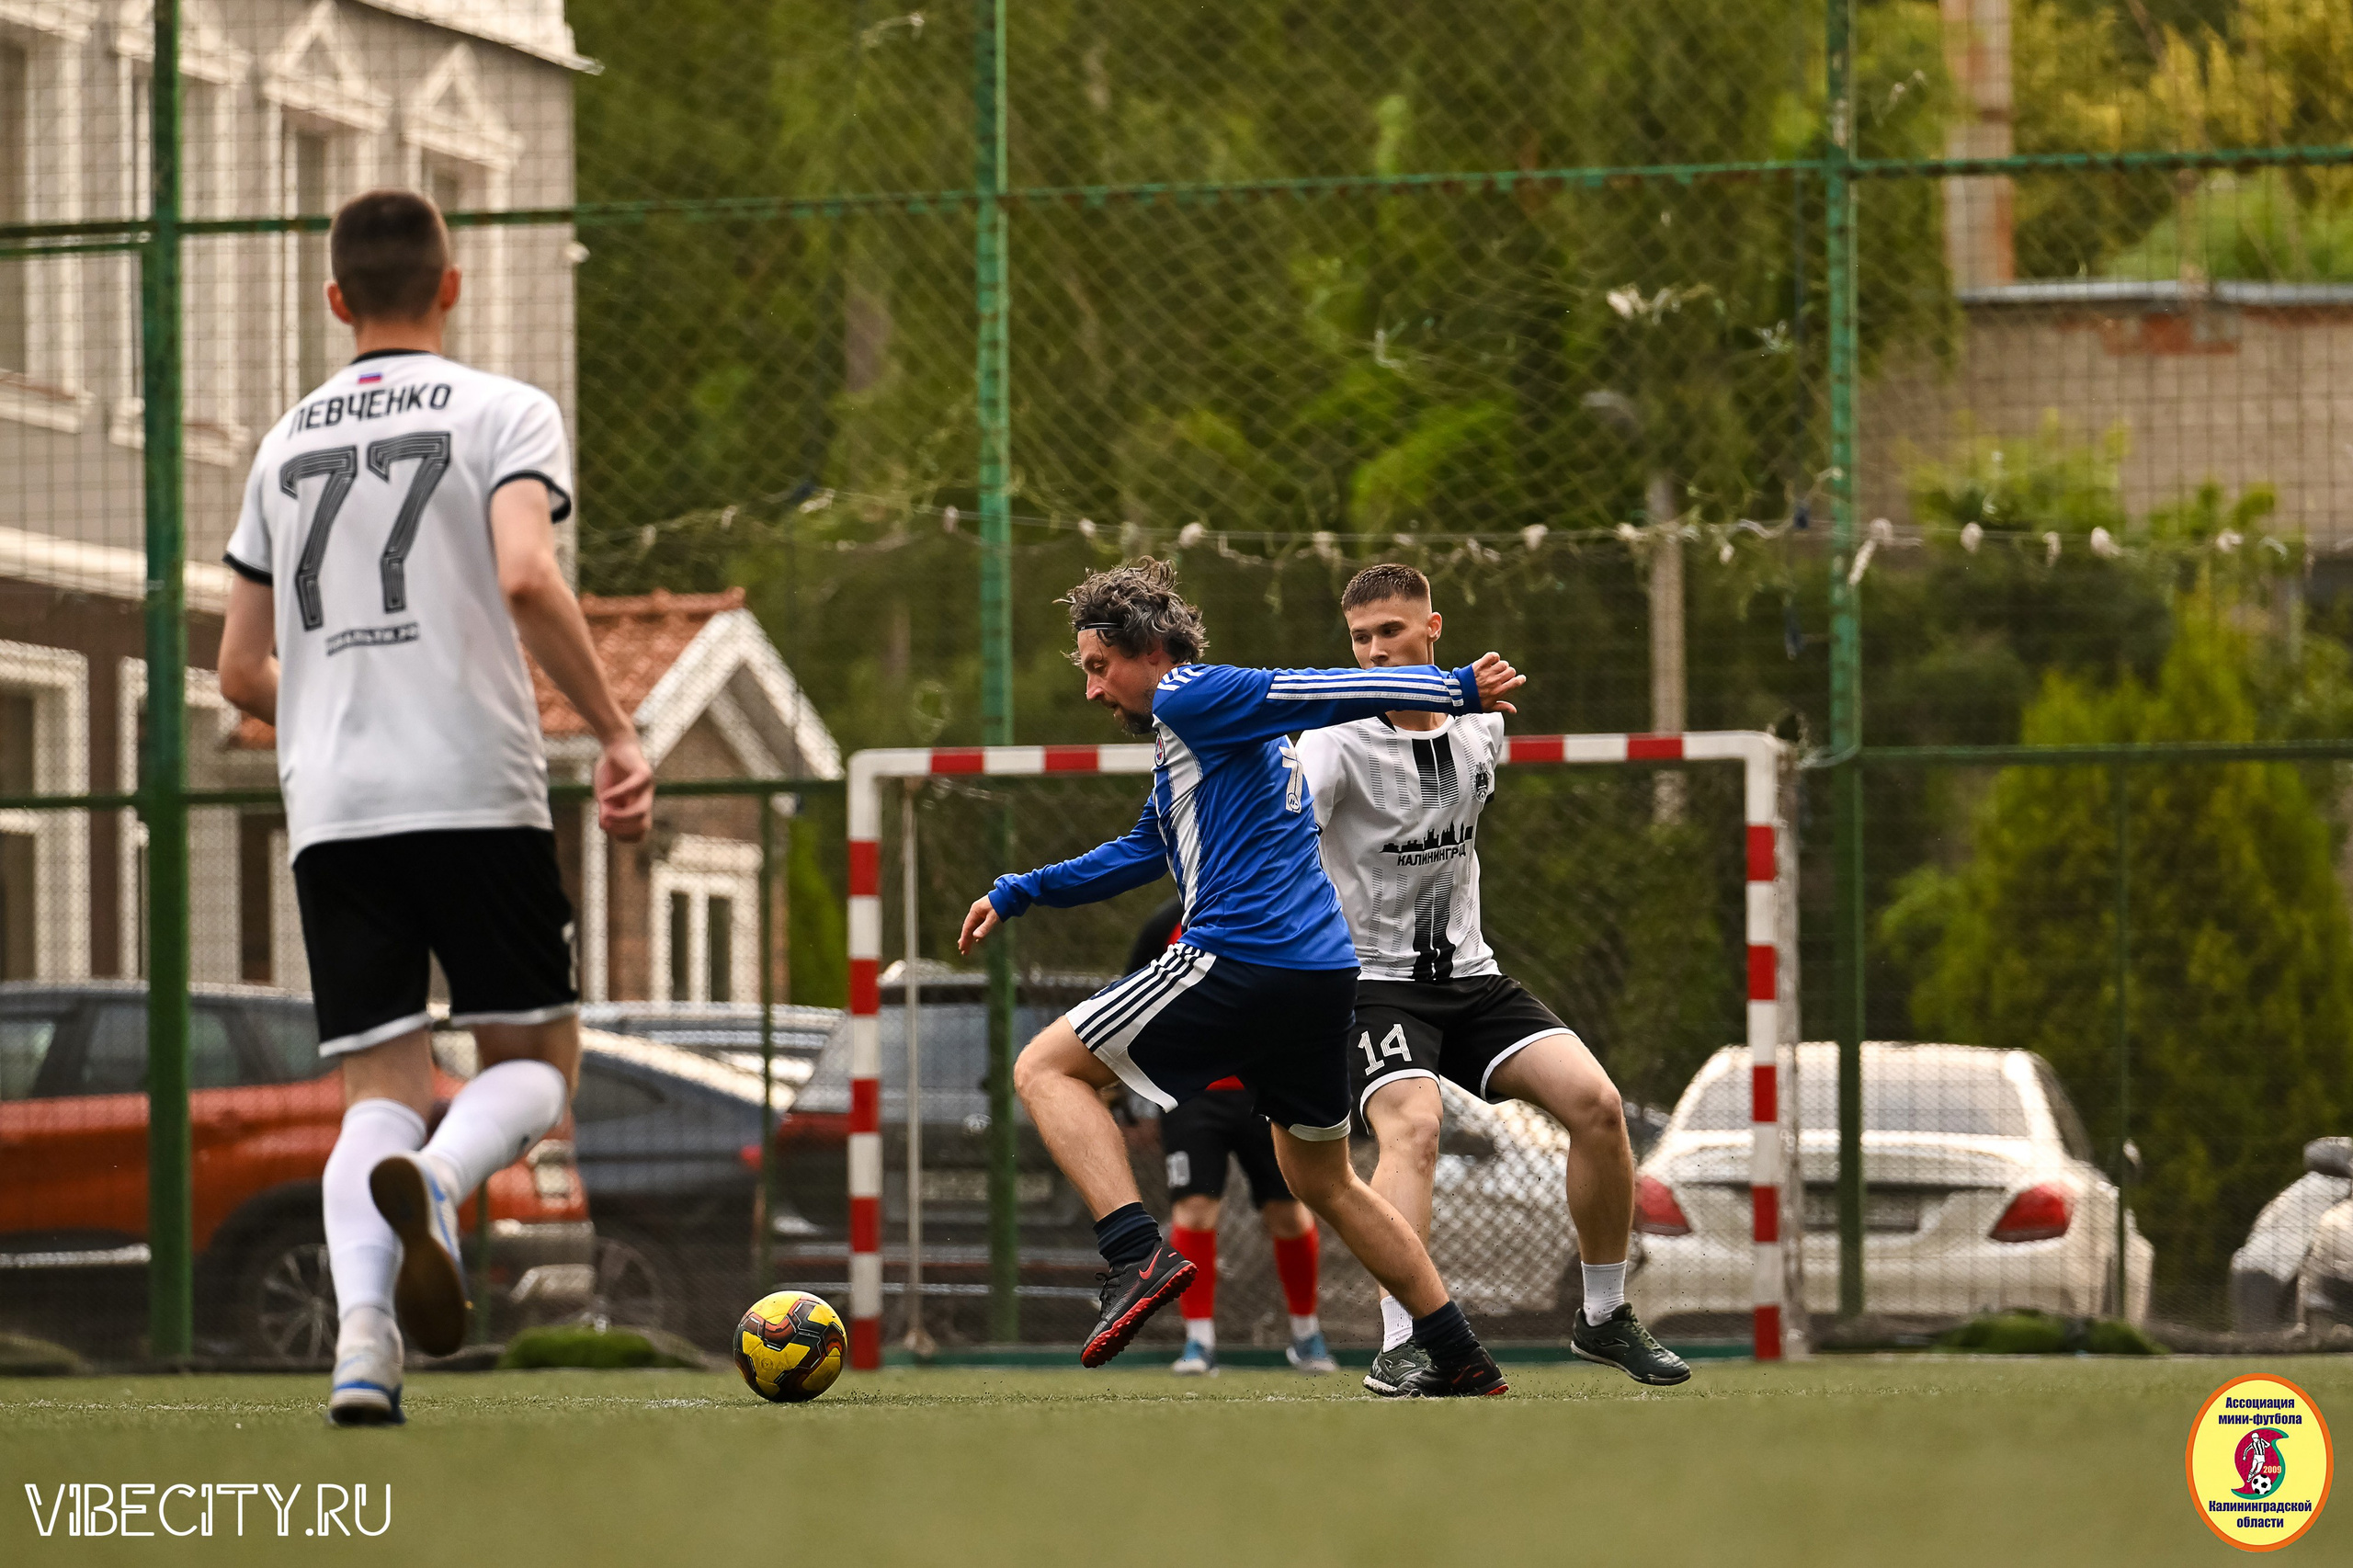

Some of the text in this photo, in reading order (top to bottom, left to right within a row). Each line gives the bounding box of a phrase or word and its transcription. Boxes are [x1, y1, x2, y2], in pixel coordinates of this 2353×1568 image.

[288, 383, 451, 439] ЛЕВЧЕНКО
[279, 431, 450, 631] 77
[1396, 843, 1467, 867] КАЛИНИНГРД
[1358, 1023, 1413, 1076] 14
